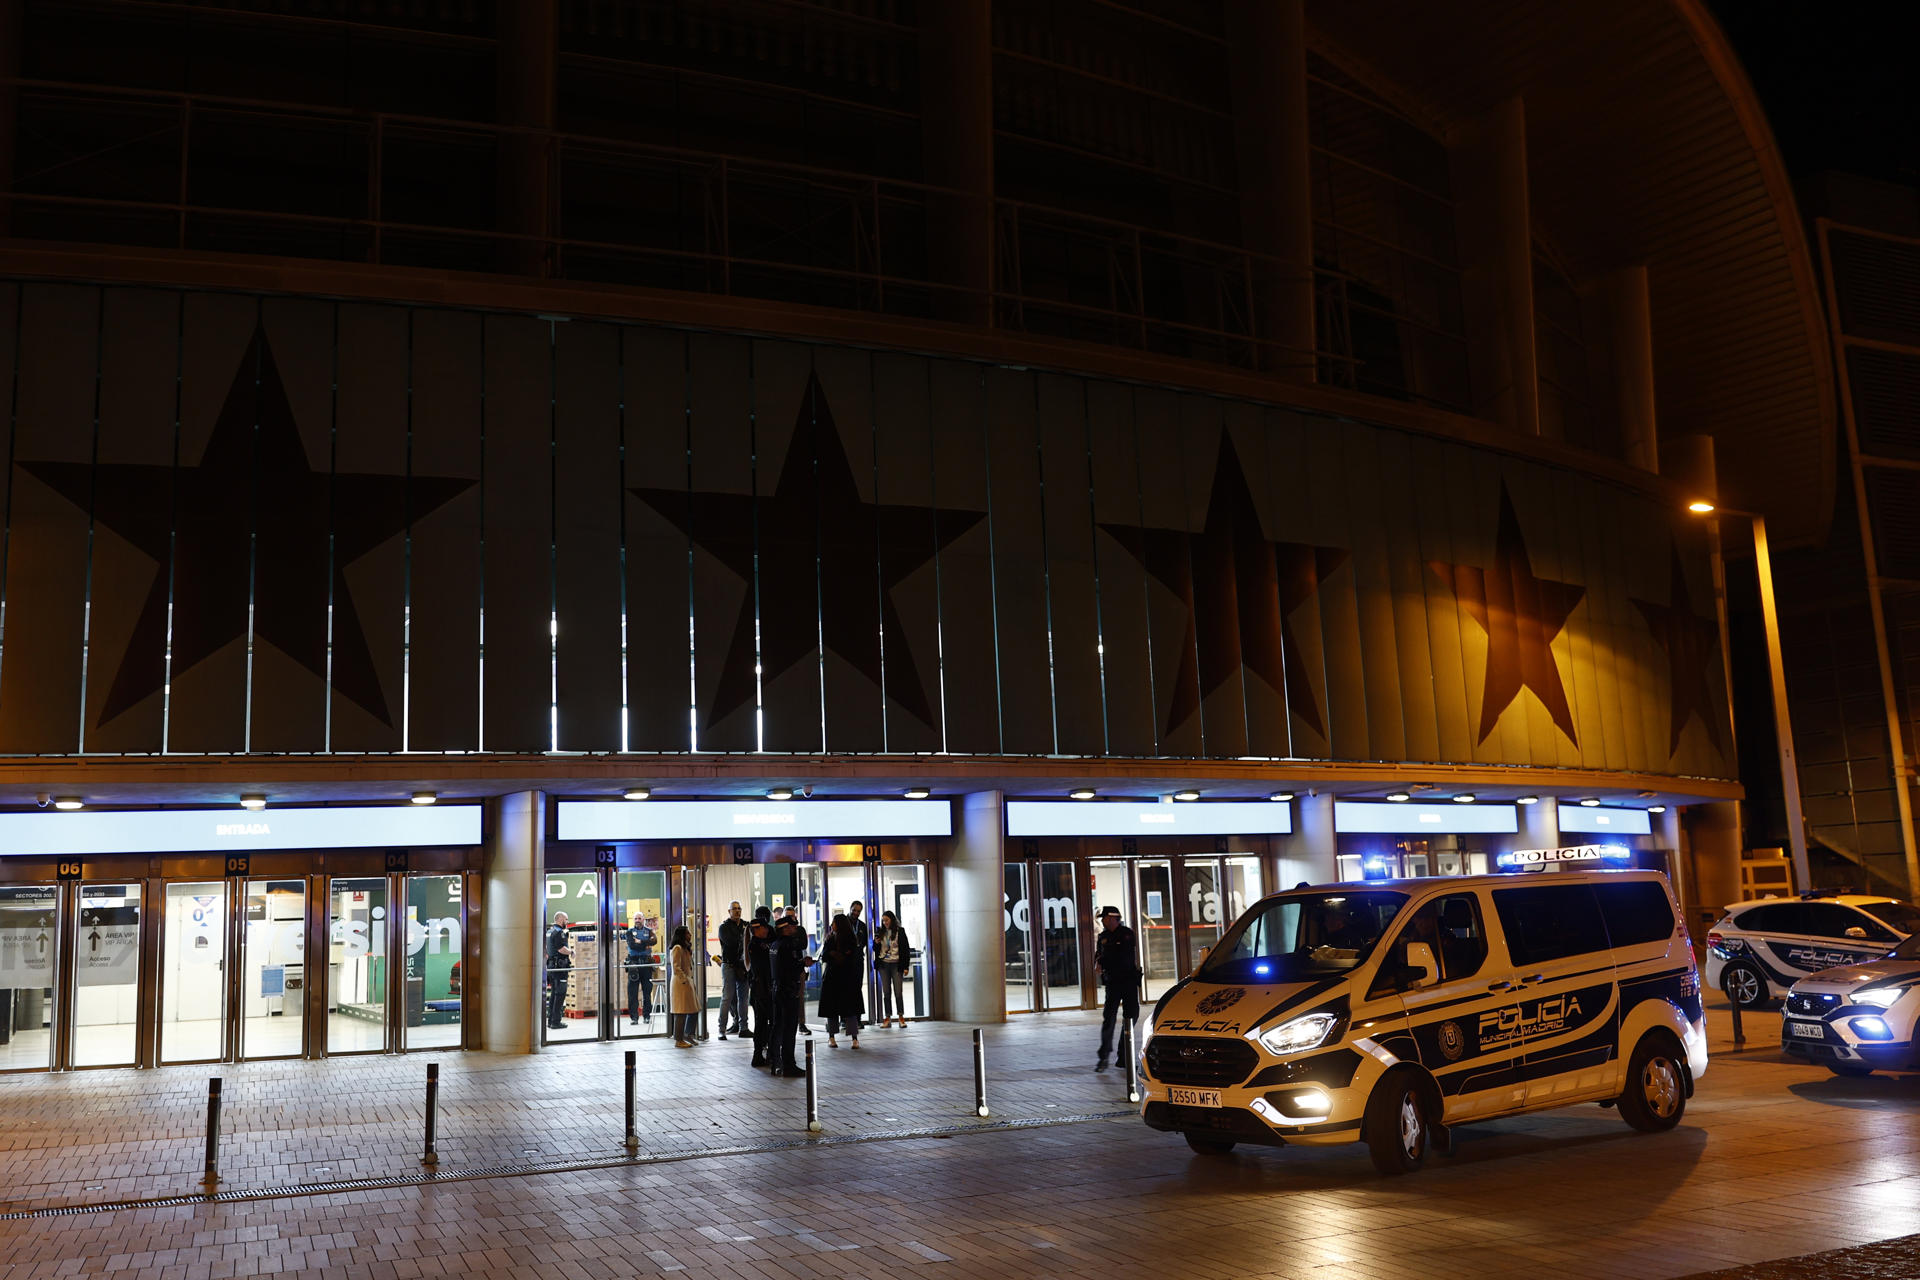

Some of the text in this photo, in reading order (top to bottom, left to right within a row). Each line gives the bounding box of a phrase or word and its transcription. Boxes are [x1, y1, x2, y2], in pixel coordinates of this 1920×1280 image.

[216, 824, 271, 835] ENTRADA
[598, 851, 615, 862] 03
[736, 848, 751, 859] 02
[866, 846, 878, 857] 01
[1514, 848, 1597, 862] POLICIA
[228, 859, 247, 871] 05
[387, 855, 406, 867] 04
[60, 863, 80, 875] 06
[1480, 1019, 1564, 1044] MUNICIPAL MADRID
[1174, 1090, 1219, 1106] 2550 MFK
